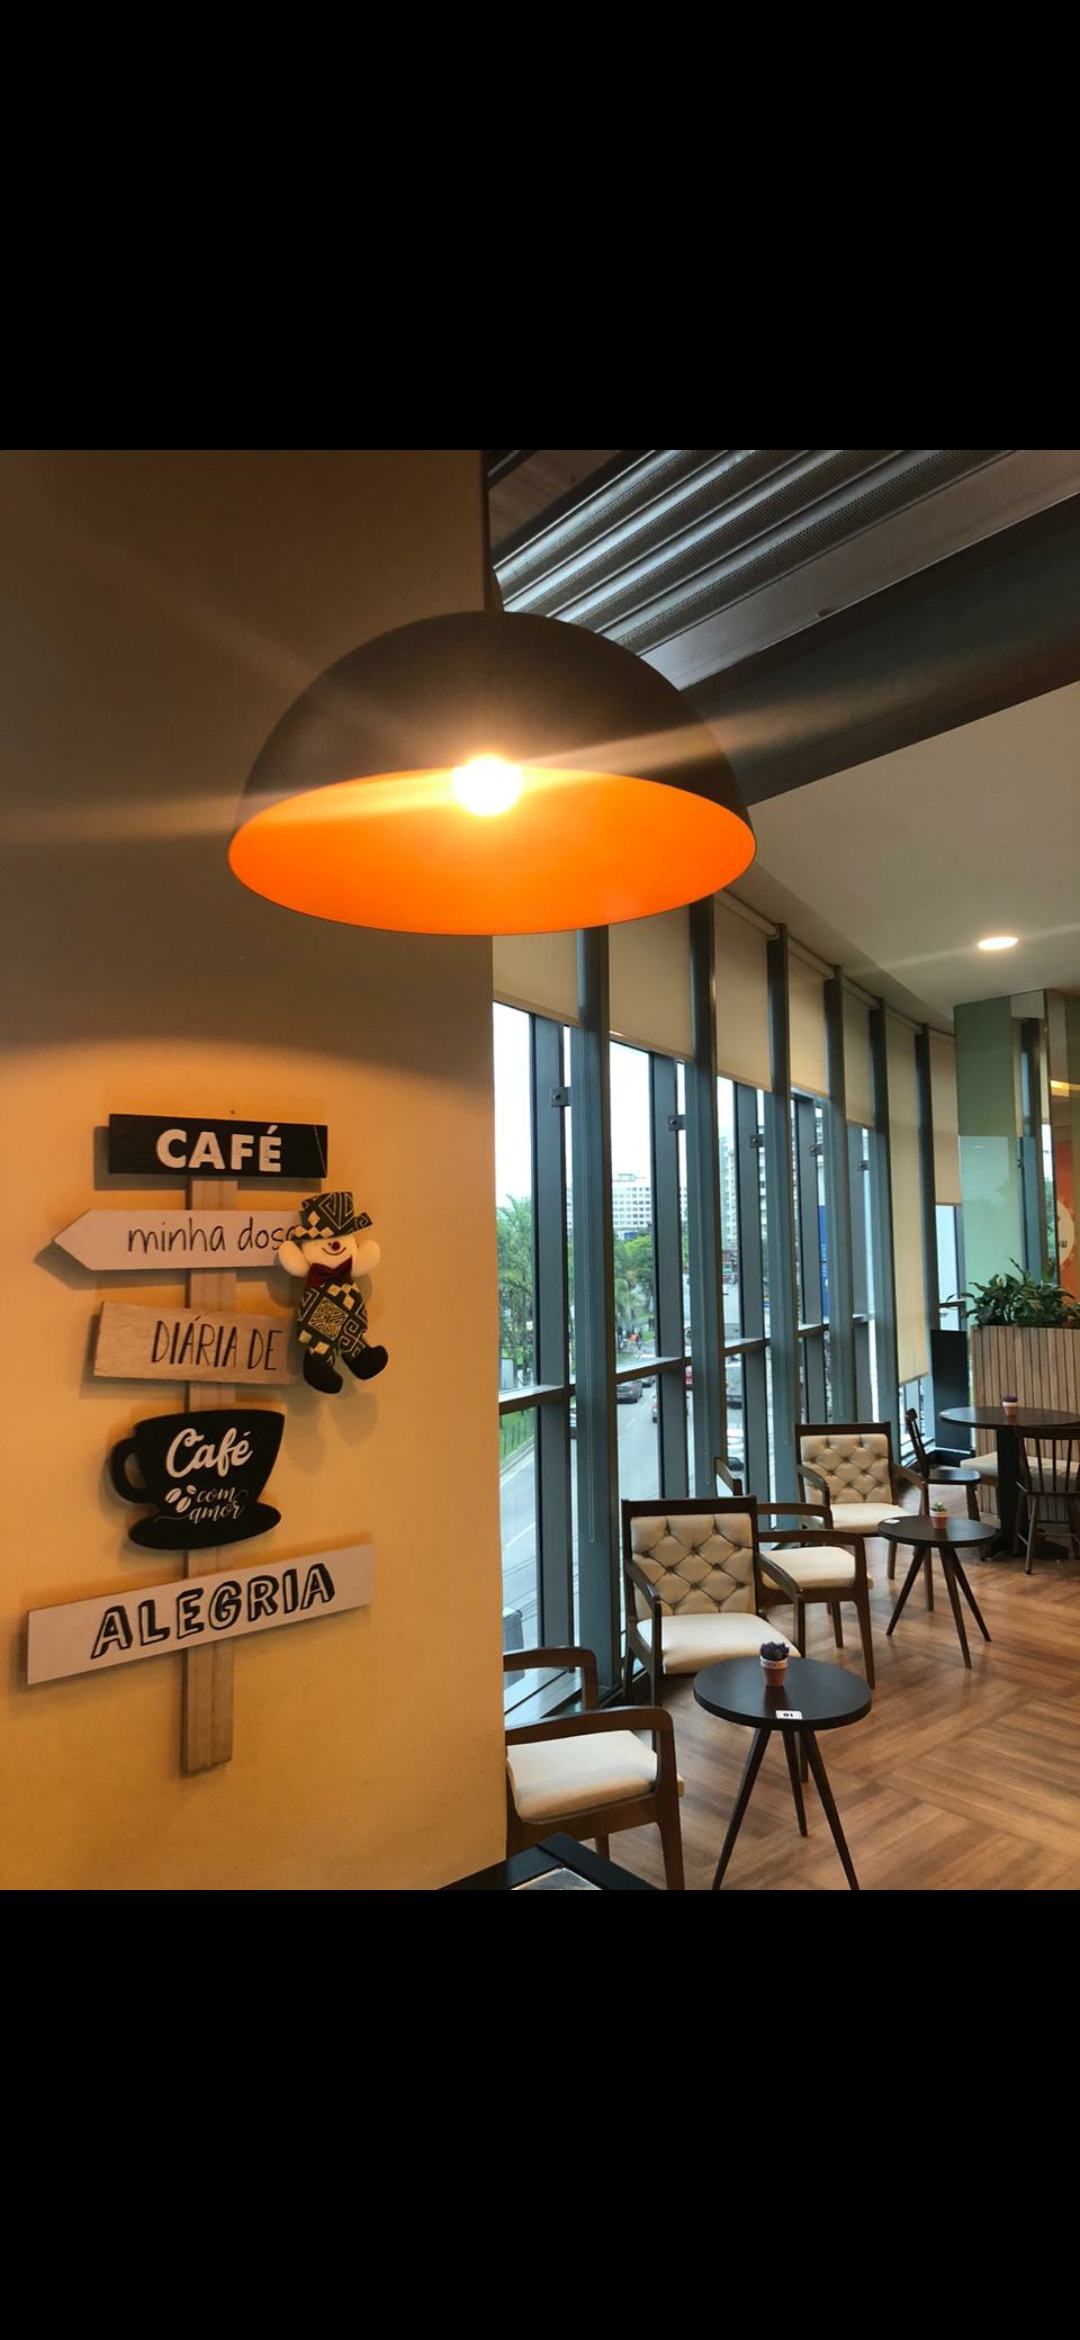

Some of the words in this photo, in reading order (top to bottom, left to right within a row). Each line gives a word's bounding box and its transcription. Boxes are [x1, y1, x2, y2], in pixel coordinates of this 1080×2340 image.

[156, 1125, 282, 1173] CAFÉ
[127, 1217, 226, 1253] minha
[151, 1316, 238, 1369] DIÁRIA
[247, 1329, 283, 1371] DE
[166, 1427, 254, 1478] Café
[189, 1500, 243, 1524] amor
[197, 1487, 236, 1502] com
[90, 1562, 336, 1660] ALEGRIA
